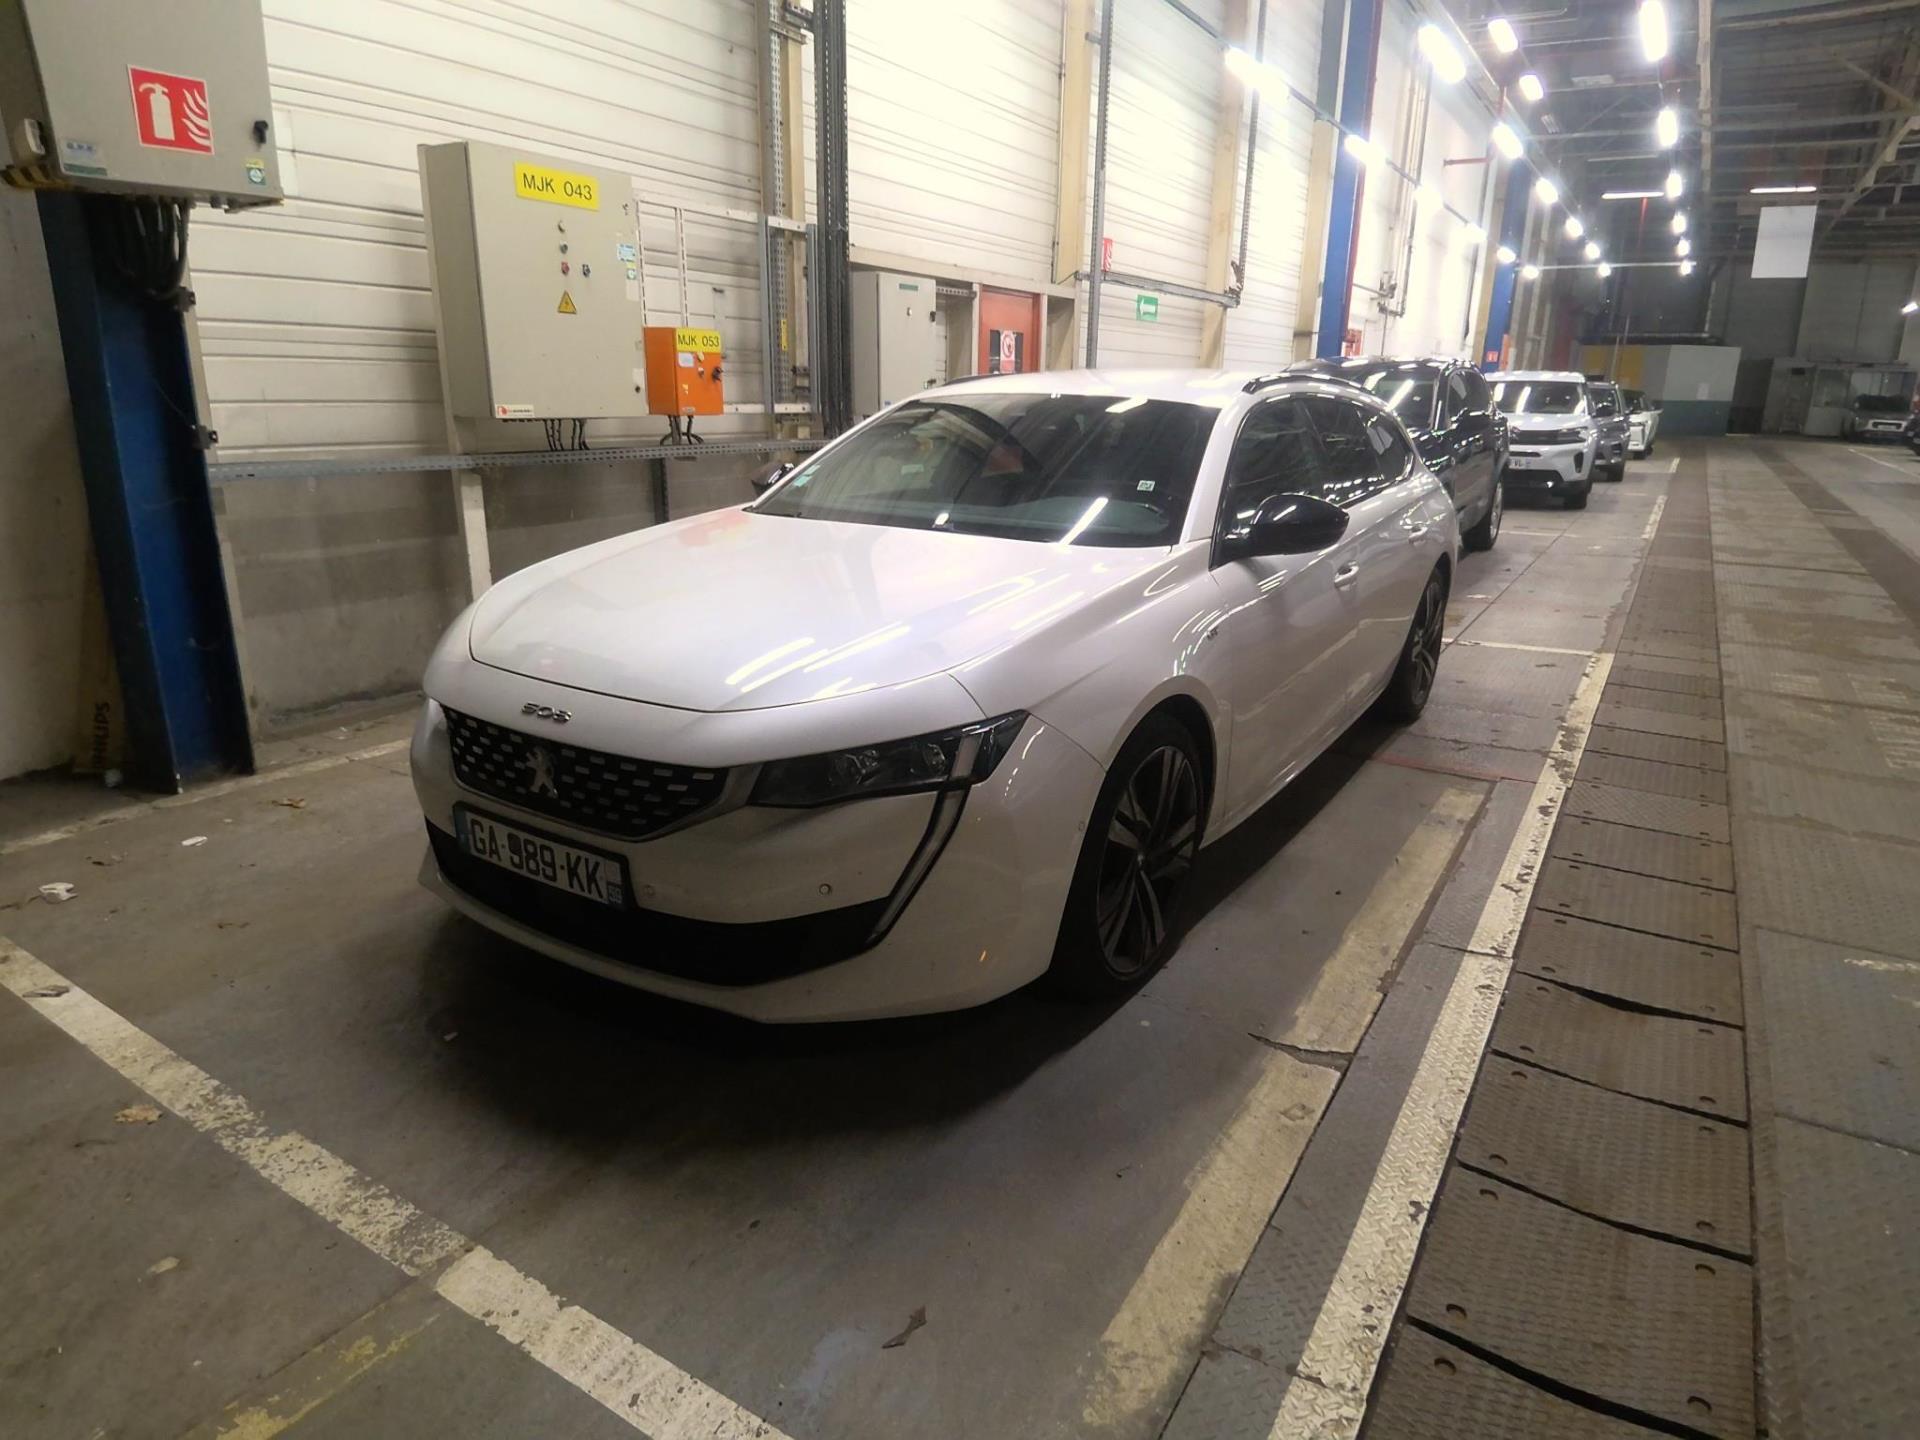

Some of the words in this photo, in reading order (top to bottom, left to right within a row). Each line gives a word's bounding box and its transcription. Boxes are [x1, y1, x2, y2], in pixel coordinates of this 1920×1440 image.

[523, 172, 556, 194] MJK
[563, 181, 593, 201] 043
[677, 333, 698, 347] MJK
[701, 335, 720, 348] 053
[521, 701, 573, 723] 508
